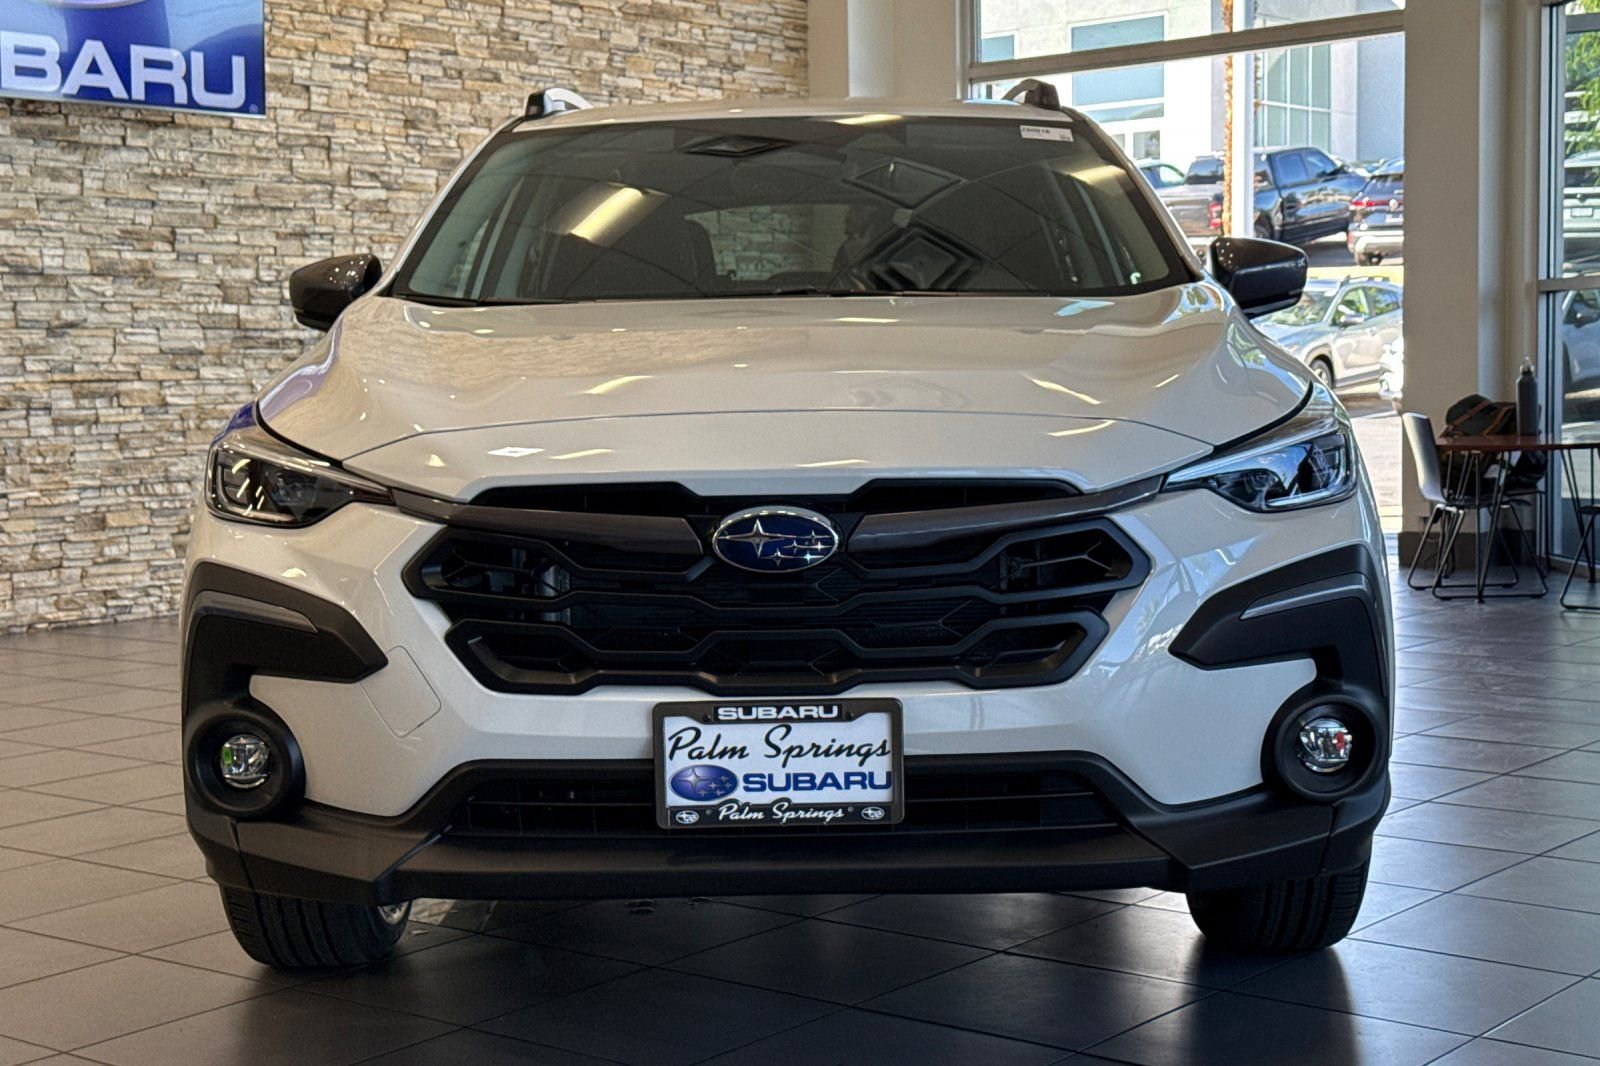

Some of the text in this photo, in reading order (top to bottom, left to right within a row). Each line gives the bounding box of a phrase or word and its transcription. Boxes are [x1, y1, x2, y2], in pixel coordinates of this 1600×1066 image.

[0, 30, 246, 109] BARU
[717, 705, 838, 720] SUBARU
[668, 724, 890, 768] Palm Springs
[743, 771, 892, 792] SUBARU
[719, 801, 844, 824] Palm Springs
